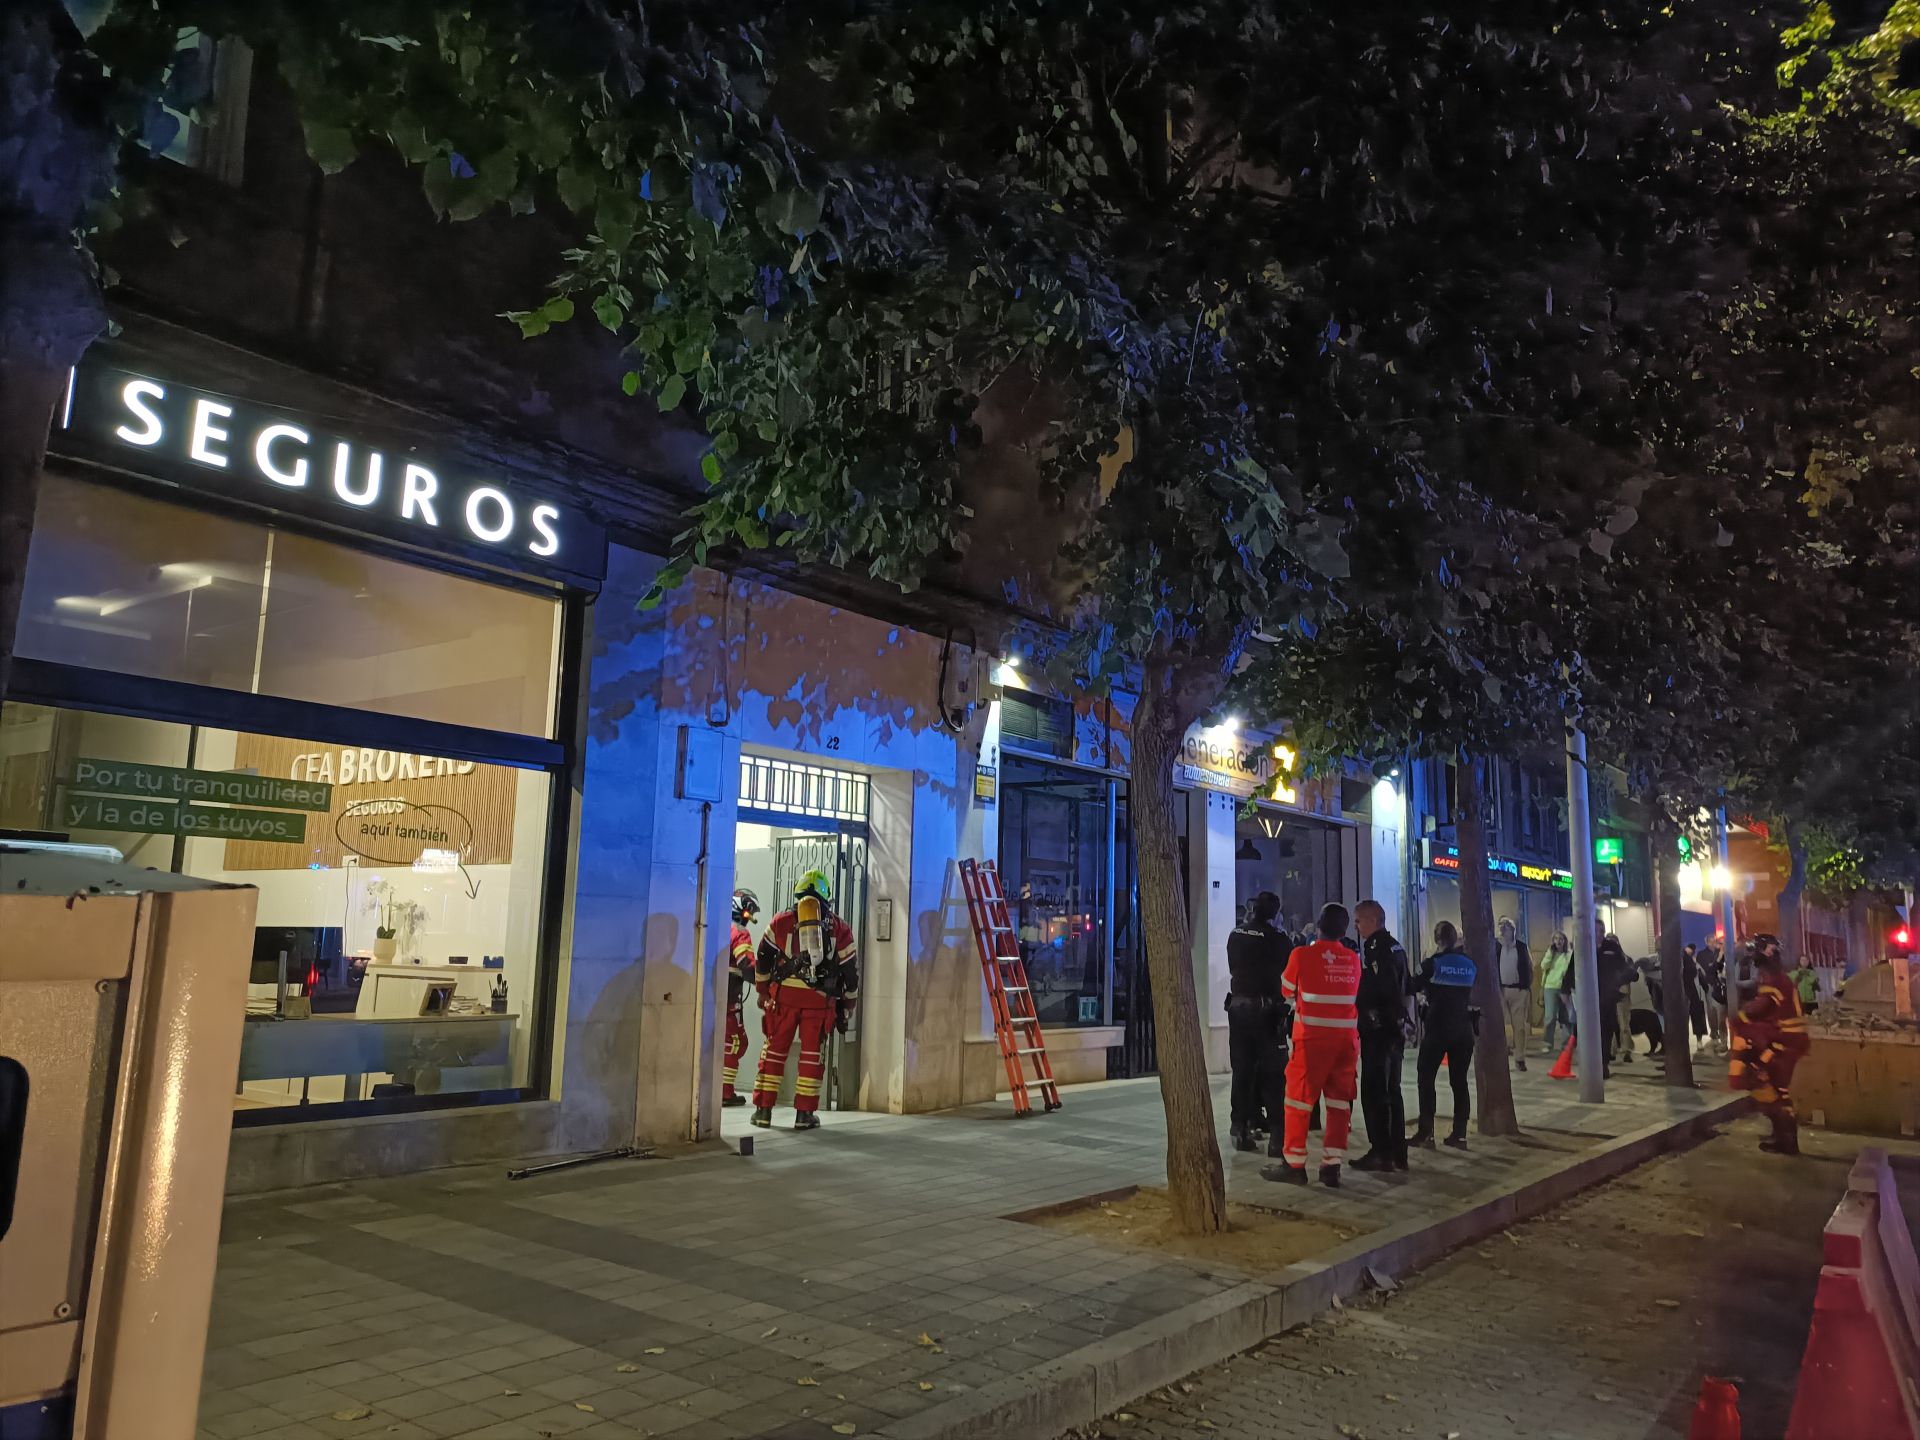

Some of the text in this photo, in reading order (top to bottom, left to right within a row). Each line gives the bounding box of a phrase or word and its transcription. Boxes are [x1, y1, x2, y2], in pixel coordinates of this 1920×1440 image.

[116, 380, 560, 557] SEGUROS
[826, 735, 840, 751] 22
[76, 763, 328, 806] Por tu tranquilidad
[68, 803, 88, 826] y
[97, 801, 120, 824] la
[129, 805, 165, 828] de
[174, 807, 211, 830] los
[345, 796, 407, 817] SEGUROS
[360, 821, 450, 844] aquí también
